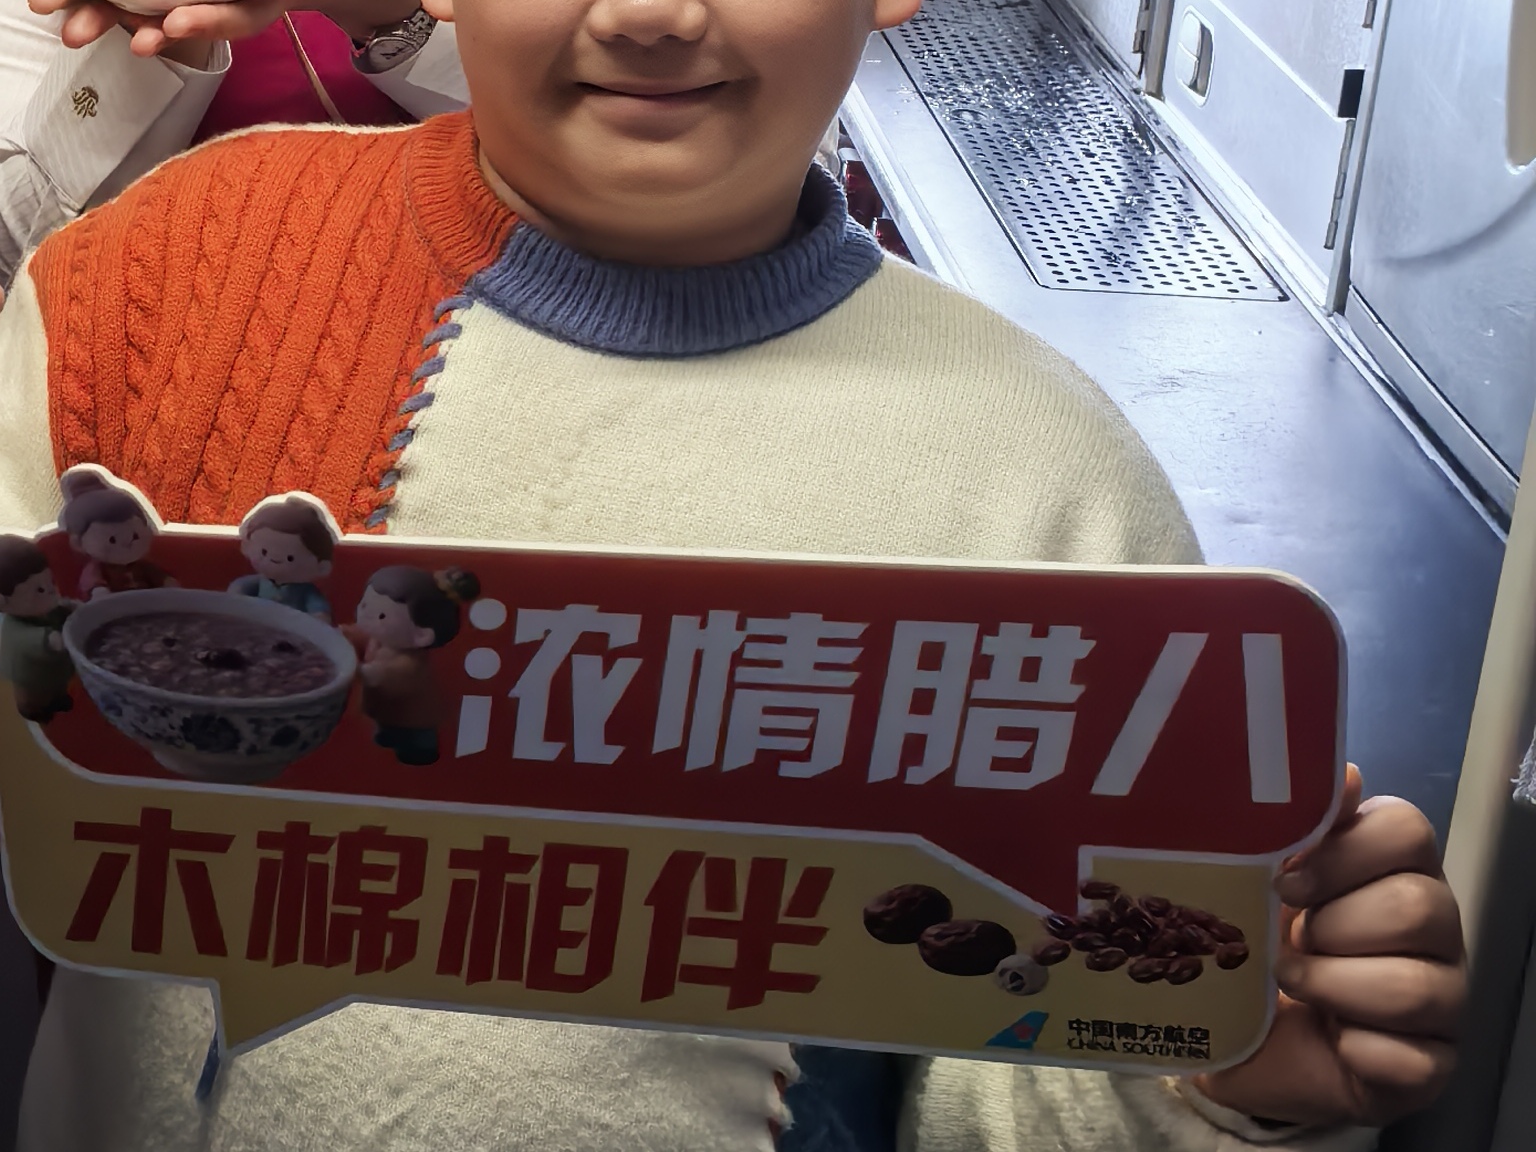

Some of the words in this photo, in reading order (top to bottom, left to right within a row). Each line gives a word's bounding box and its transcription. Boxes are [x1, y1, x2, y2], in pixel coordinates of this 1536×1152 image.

[456, 599, 1291, 804] 浓情腊八
[67, 807, 837, 1010] 木棉相伴
